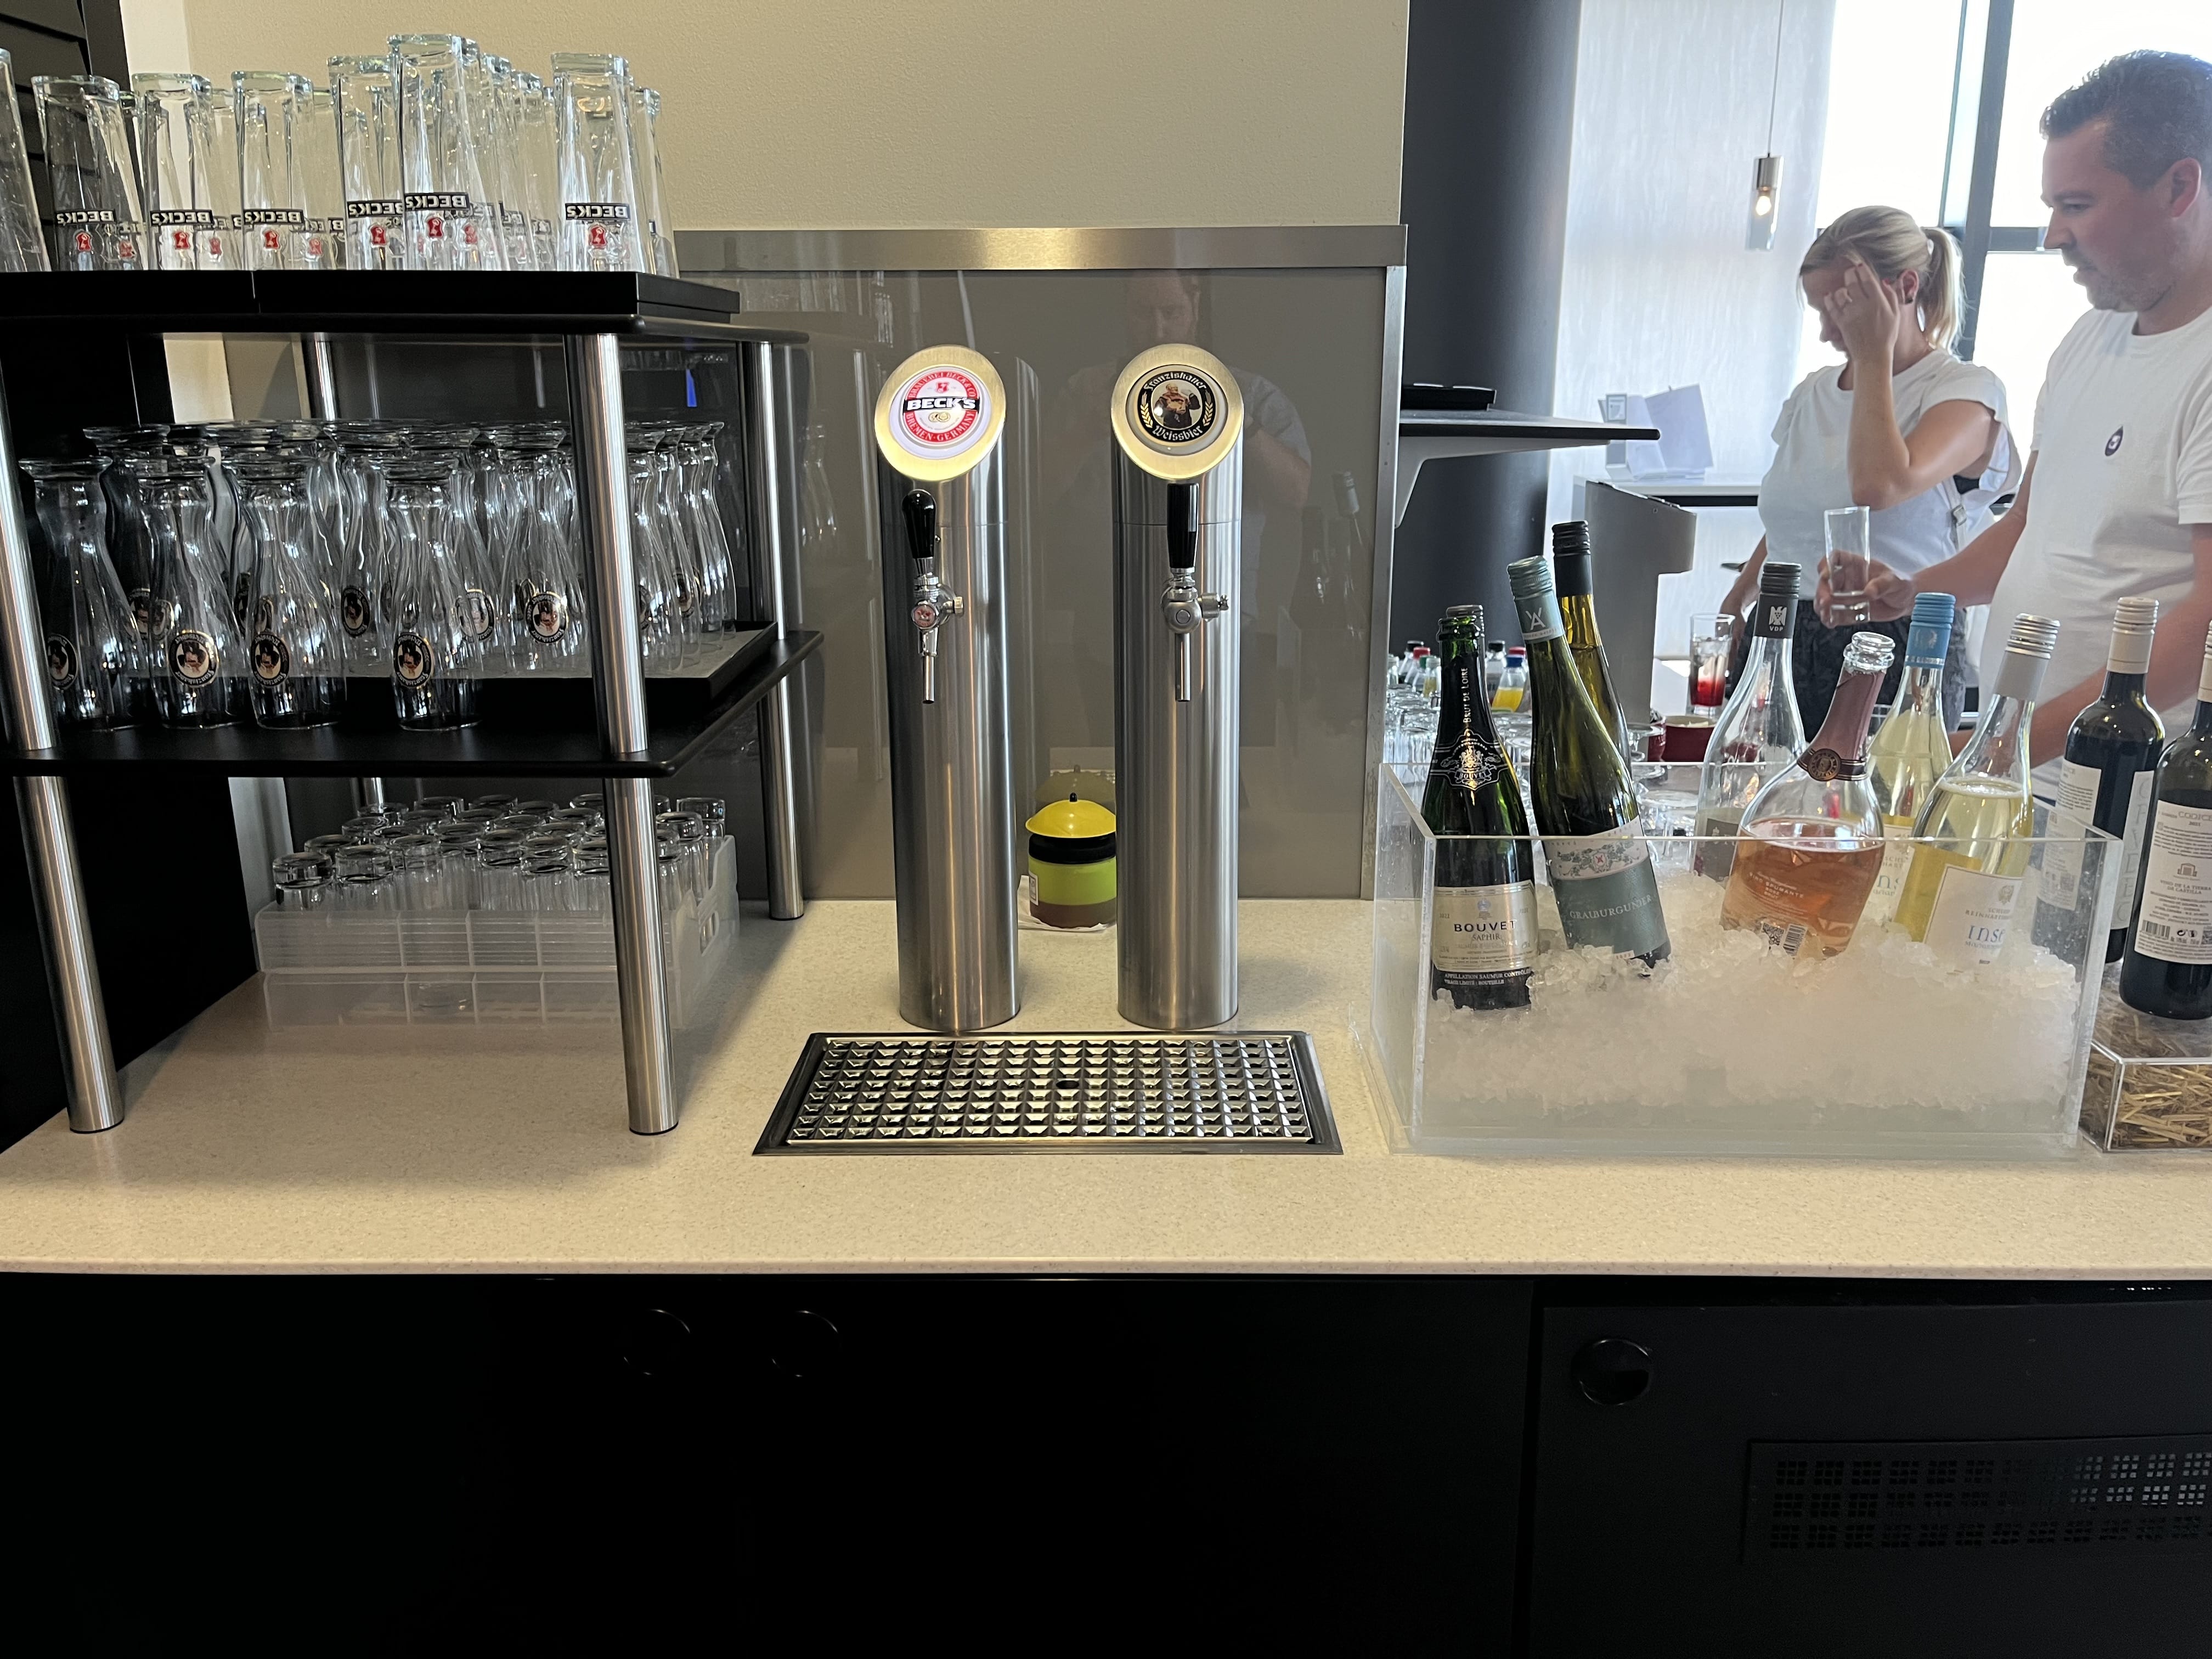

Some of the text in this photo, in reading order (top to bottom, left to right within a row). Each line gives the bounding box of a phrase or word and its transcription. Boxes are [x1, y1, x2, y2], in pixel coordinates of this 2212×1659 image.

[908, 371, 944, 399] BRAUEREI
[1143, 371, 1206, 391] Franziskaner
[907, 397, 975, 410] BECK'S
[1152, 425, 1203, 441] Weissbier
[1454, 920, 1517, 932] BOUVET
[1472, 933, 1501, 941] SAPHIR
